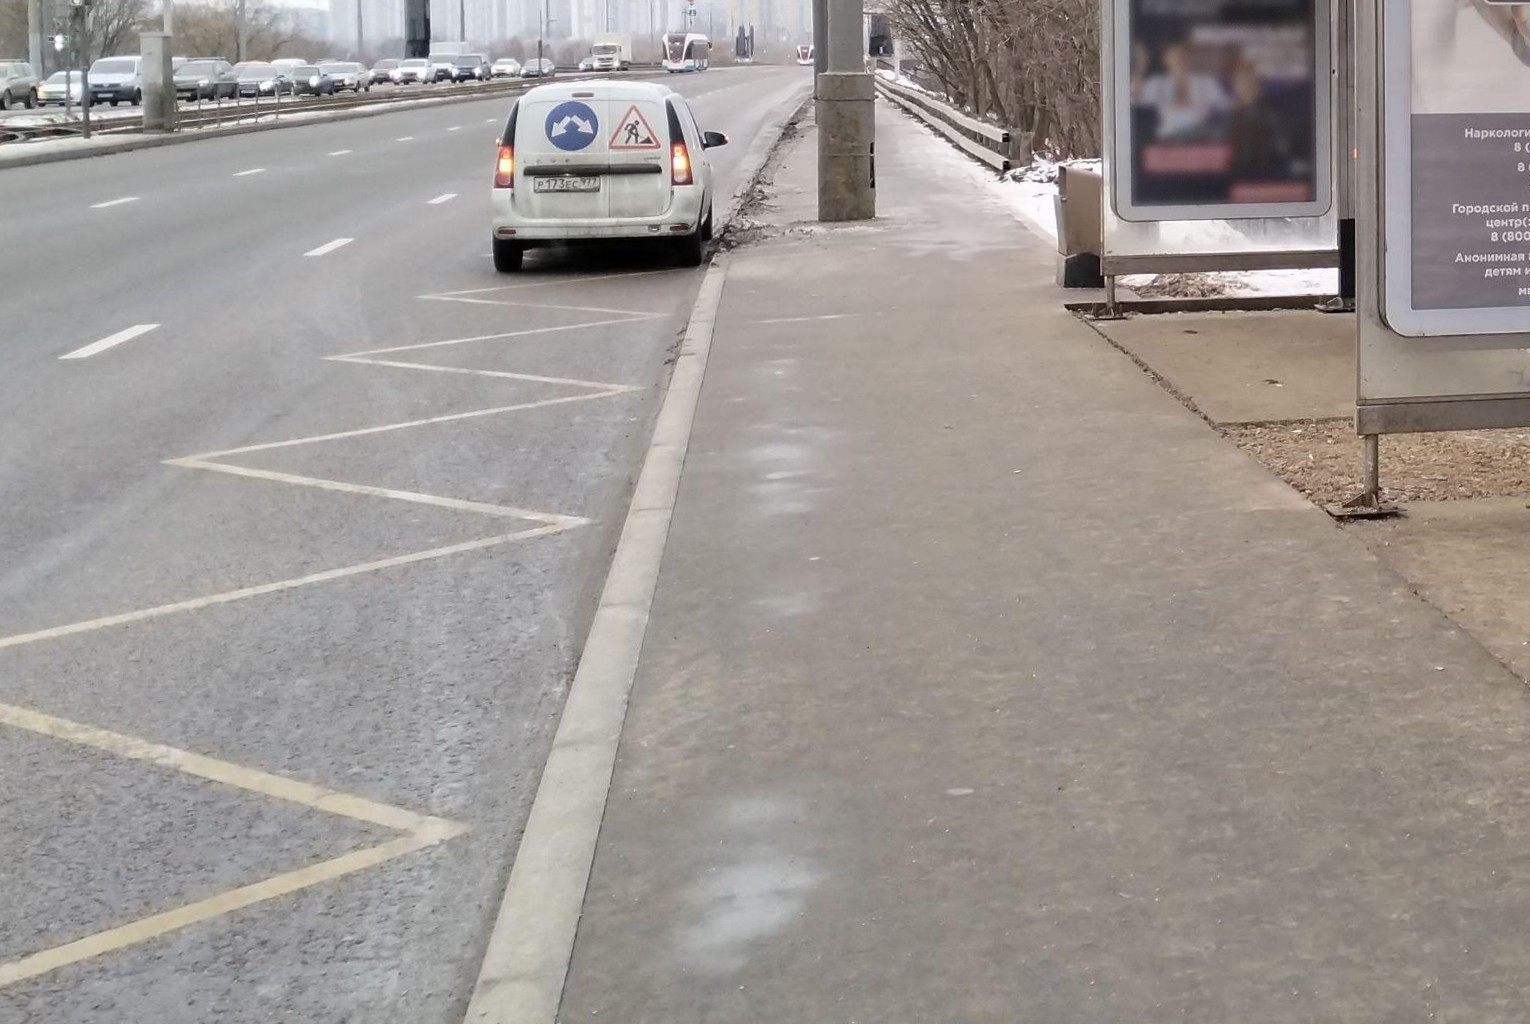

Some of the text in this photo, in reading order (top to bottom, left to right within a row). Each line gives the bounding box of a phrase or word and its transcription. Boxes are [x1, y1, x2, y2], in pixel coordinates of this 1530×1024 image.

[1513, 142, 1522, 152] 8
[1517, 162, 1525, 172] 8
[1452, 202, 1518, 215] Городской
[1490, 231, 1499, 242] 8
[1454, 252, 1525, 264] Анонимная
[1484, 266, 1521, 278] детям
